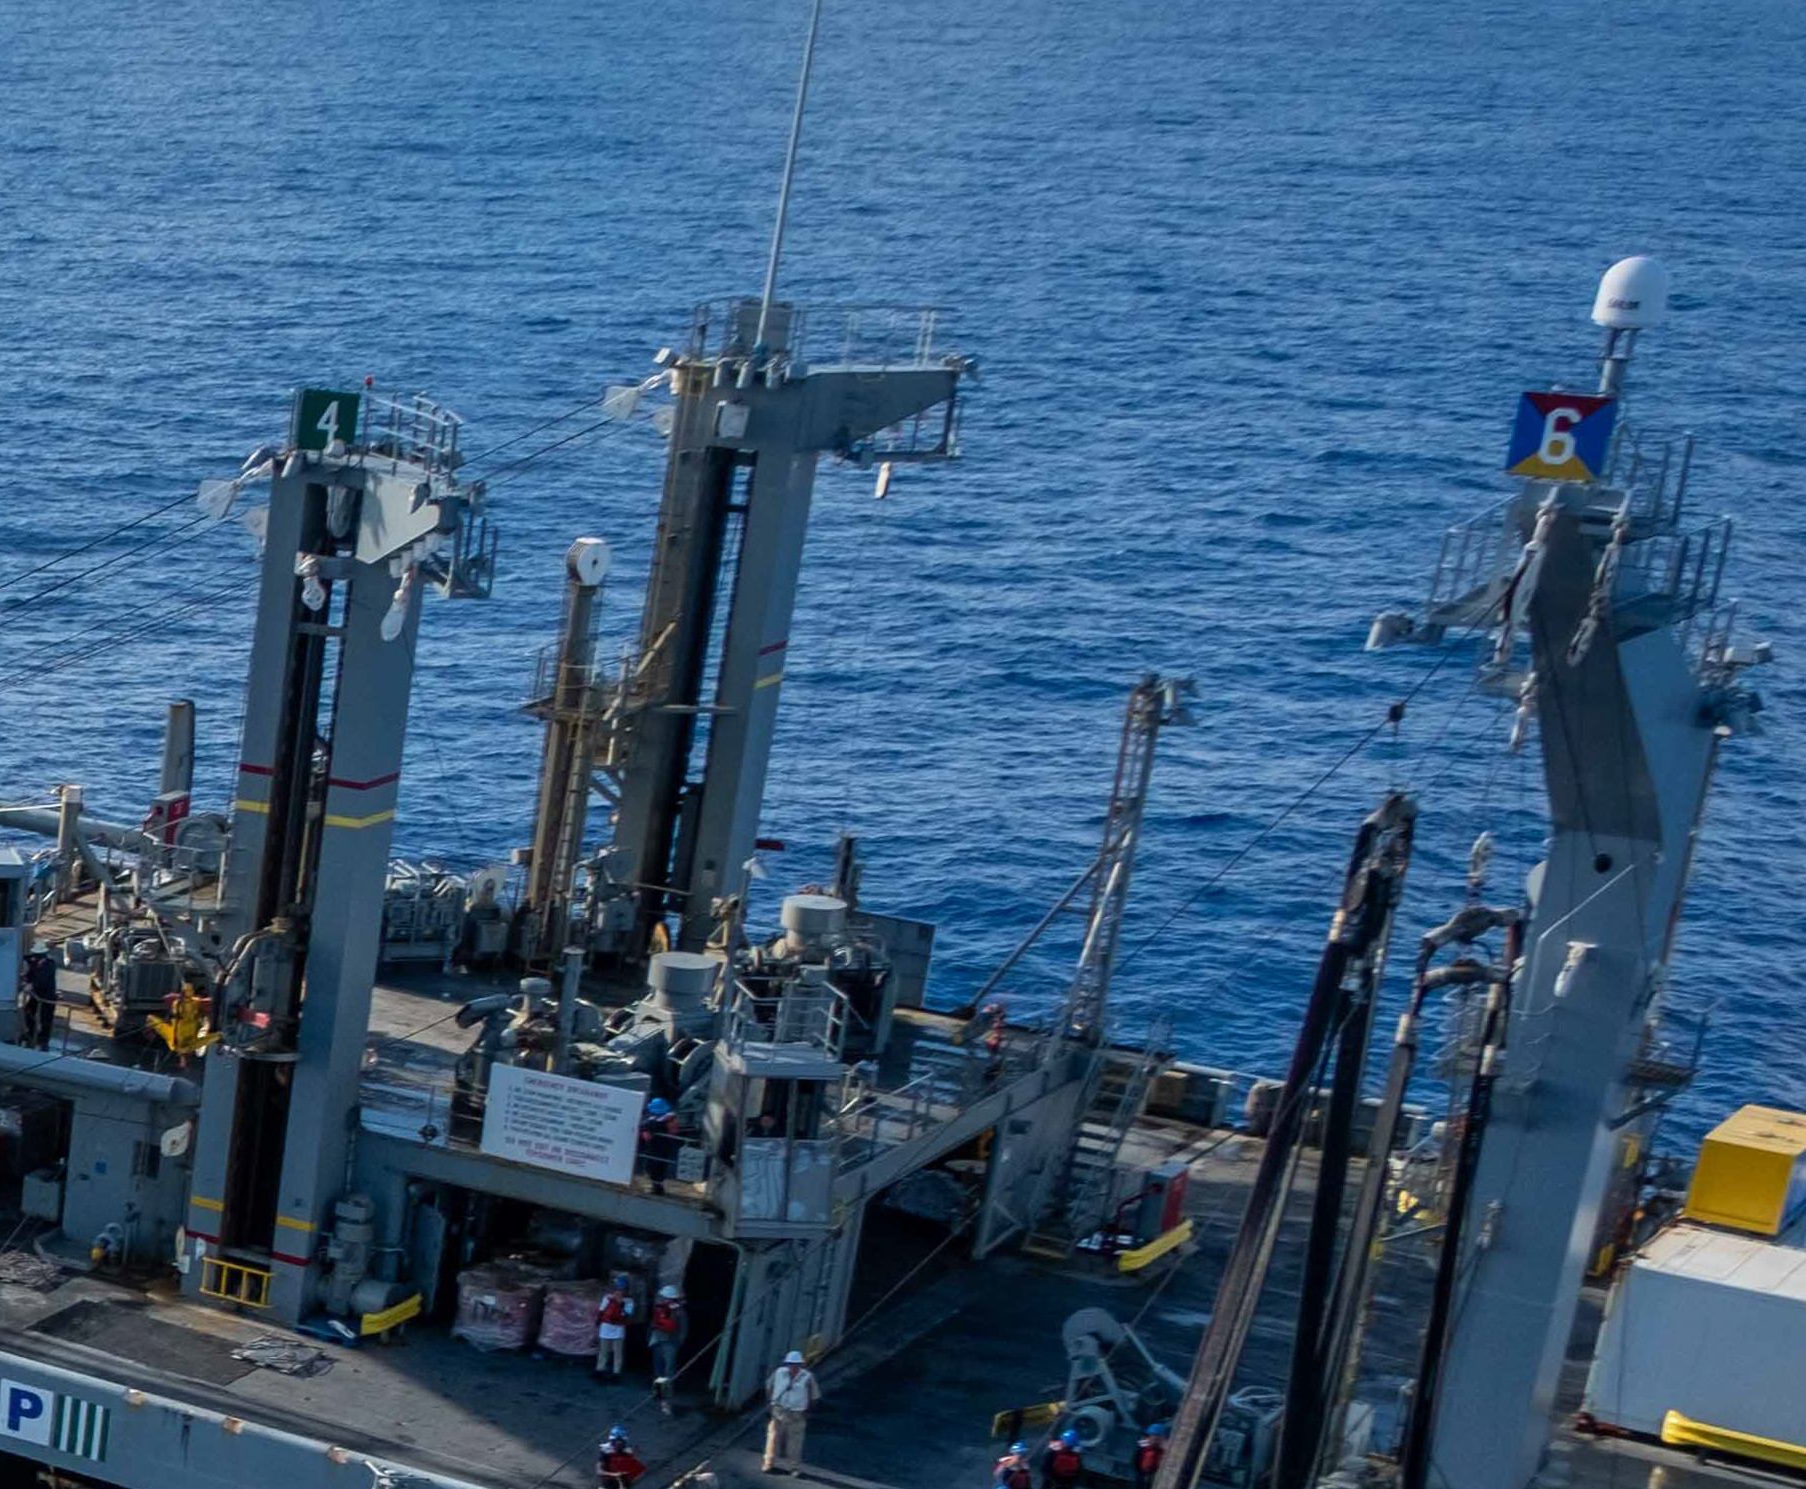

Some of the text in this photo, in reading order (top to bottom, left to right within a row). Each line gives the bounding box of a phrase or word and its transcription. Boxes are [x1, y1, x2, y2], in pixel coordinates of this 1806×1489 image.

[316, 400, 340, 444] 4
[1538, 407, 1582, 466] 6
[8, 1387, 44, 1432] P
